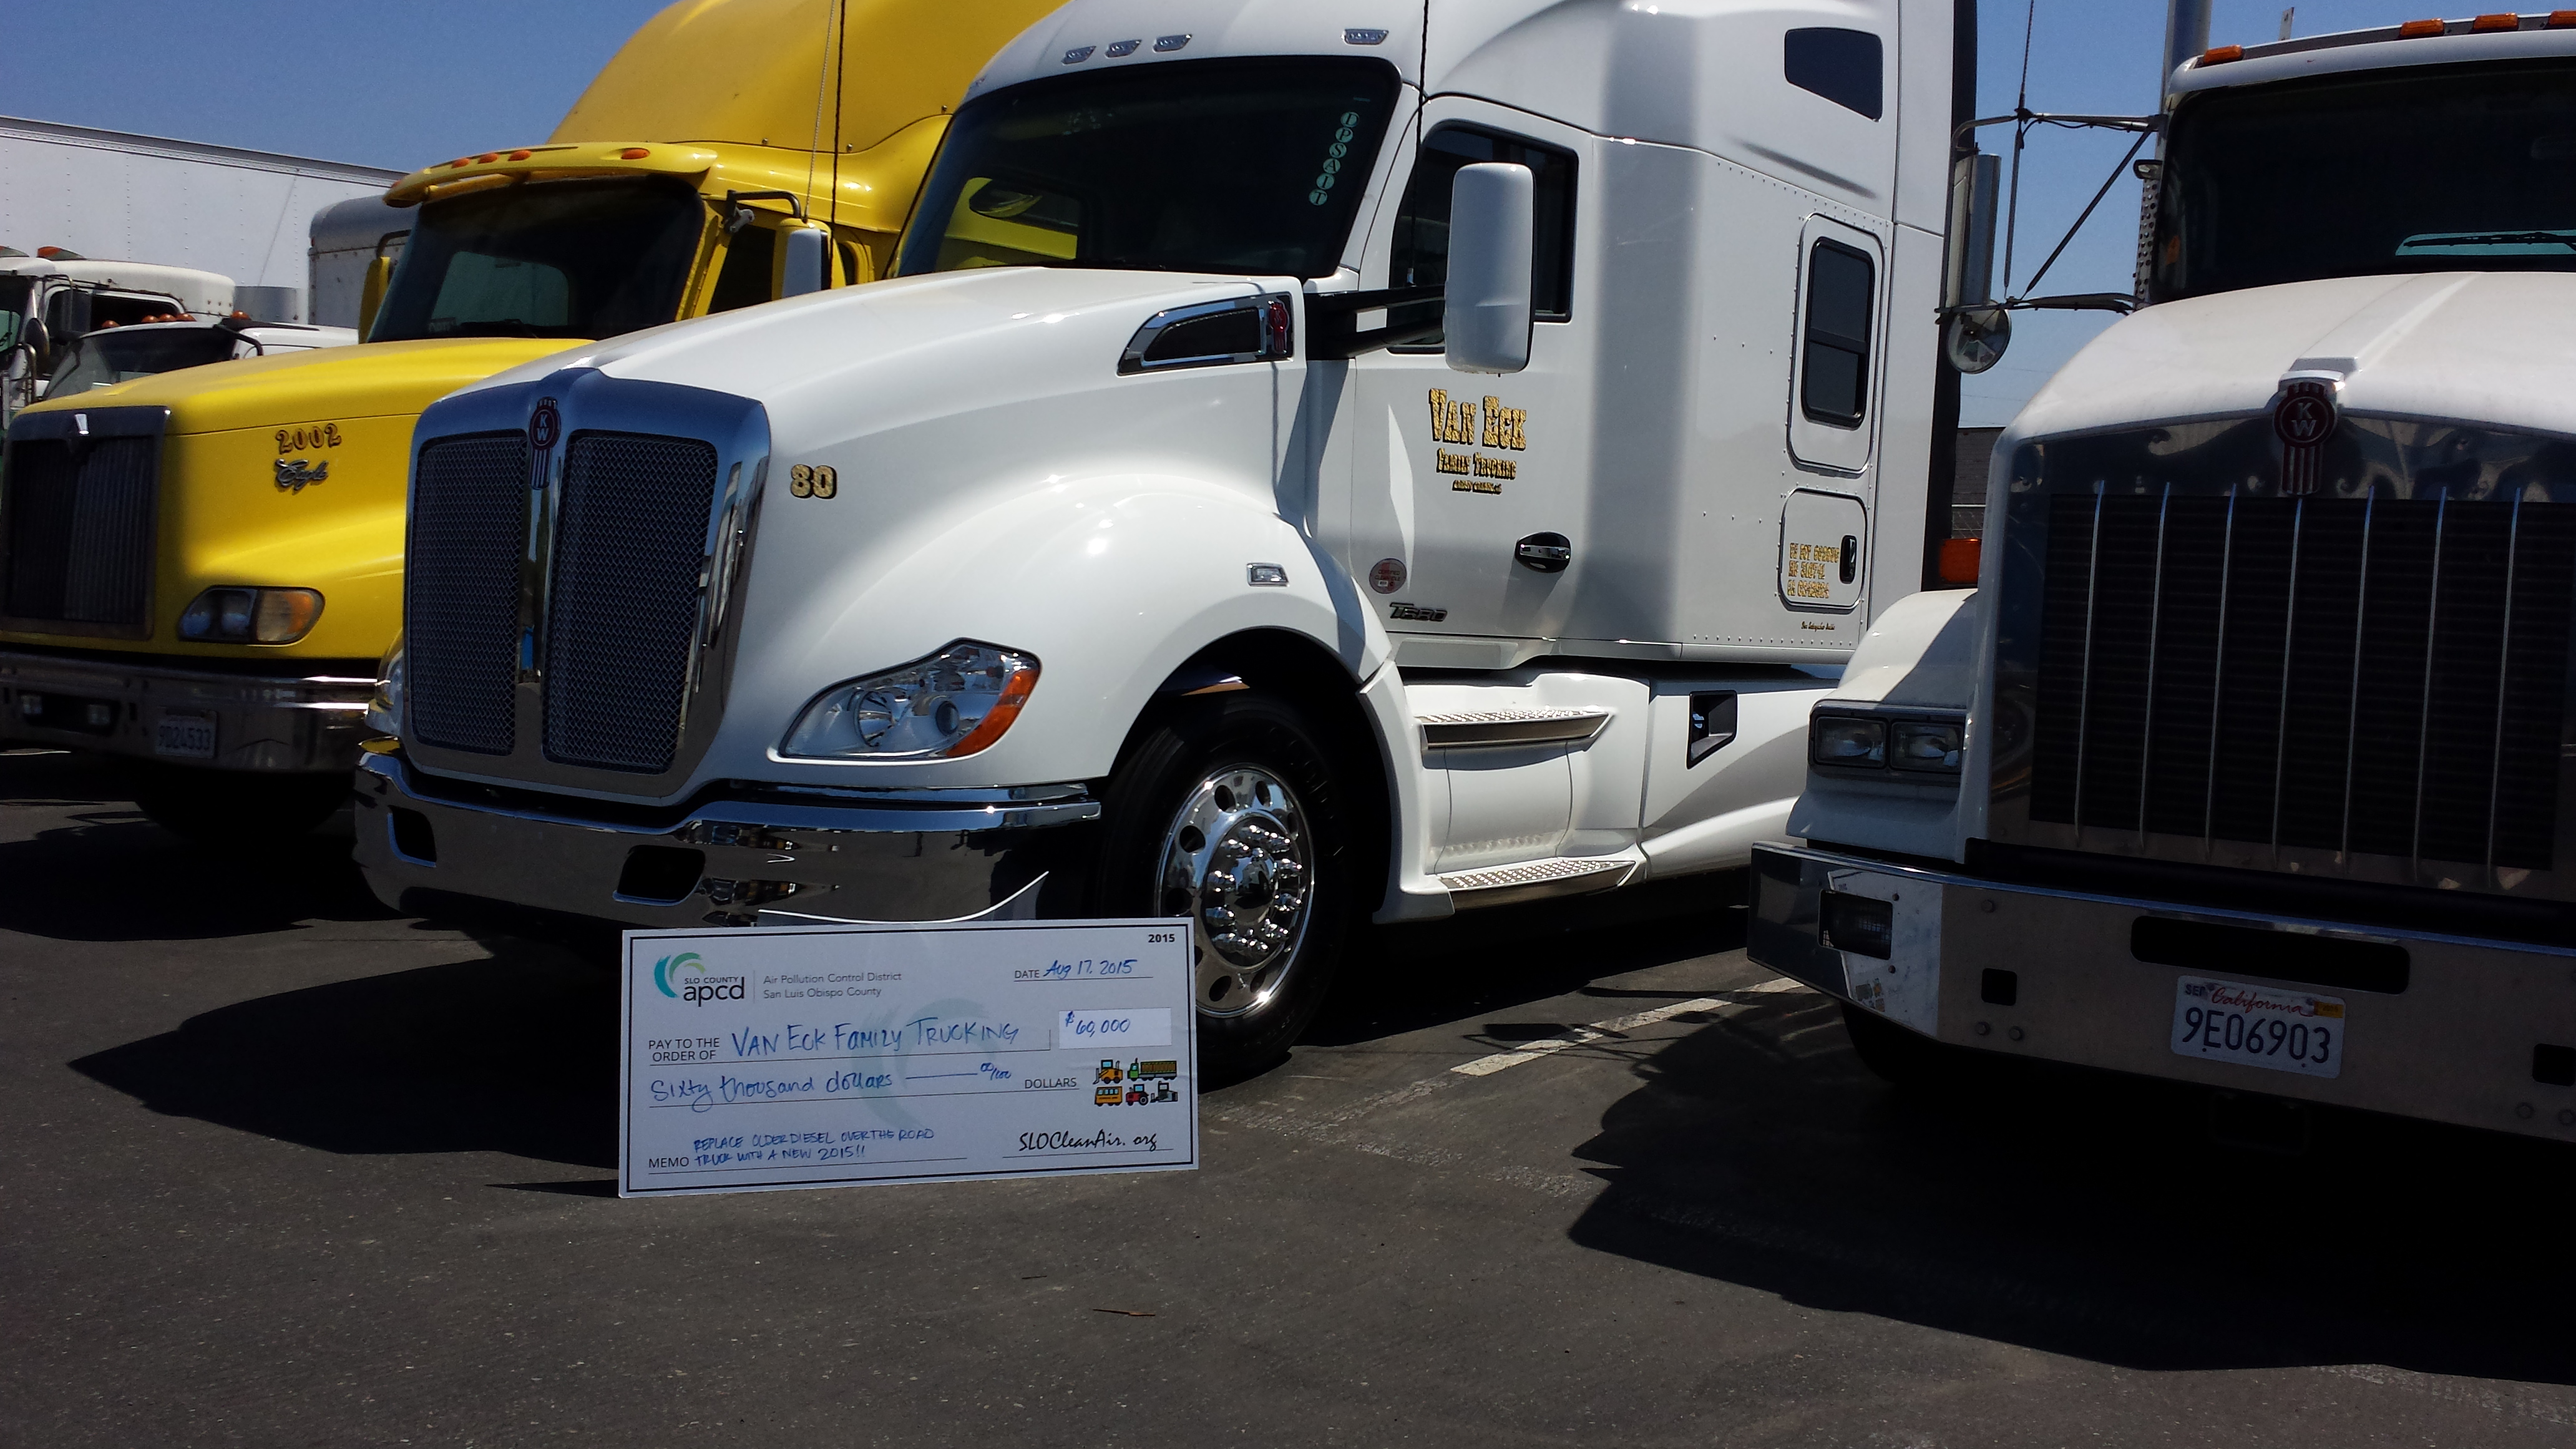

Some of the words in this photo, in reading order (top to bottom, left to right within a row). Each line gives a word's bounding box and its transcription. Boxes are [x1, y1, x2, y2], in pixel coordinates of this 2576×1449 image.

[275, 423, 342, 454] 2002
[791, 464, 837, 499] 80
[1390, 602, 1448, 622] T680
[1148, 934, 1175, 943] 2015
[763, 975, 778, 984] Air
[781, 974, 824, 983] Pollution
[828, 973, 864, 982] Control
[867, 972, 902, 982] District
[1015, 969, 1040, 978] DATE
[1043, 960, 1071, 980] Aug
[1100, 959, 1138, 975] 2015
[683, 977, 745, 1007] apcd
[763, 990, 781, 998] San
[785, 989, 804, 998] Luis
[807, 988, 842, 999] Obispo
[847, 987, 881, 998] County
[2211, 987, 2313, 1017] California
[648, 1040, 671, 1050] PAY
[675, 1038, 692, 1048] TO
[696, 1038, 720, 1048] THE
[732, 1027, 779, 1057] VAN
[906, 1017, 1019, 1046] TRUCKING
[2182, 1007, 2330, 1063] 9E06903
[652, 1051, 695, 1061] ORDER
[699, 1050, 716, 1060] OF
[651, 1080, 714, 1113] Sixty
[720, 1075, 815, 1103] thousand
[1025, 1078, 1077, 1089] DOLLARS
[694, 1136, 743, 1151] REPLACE
[752, 1133, 788, 1147] OLDER
[791, 1131, 836, 1146] DIESEL
[841, 1130, 868, 1142] OVER
[899, 1128, 934, 1141] ROAD
[648, 1157, 690, 1168] MEMO
[694, 1151, 733, 1167] TRUCK
[737, 1151, 763, 1163] WITH
[768, 1150, 778, 1160] A
[782, 1148, 812, 1159] NEW
[817, 1144, 866, 1161] 2015!!
